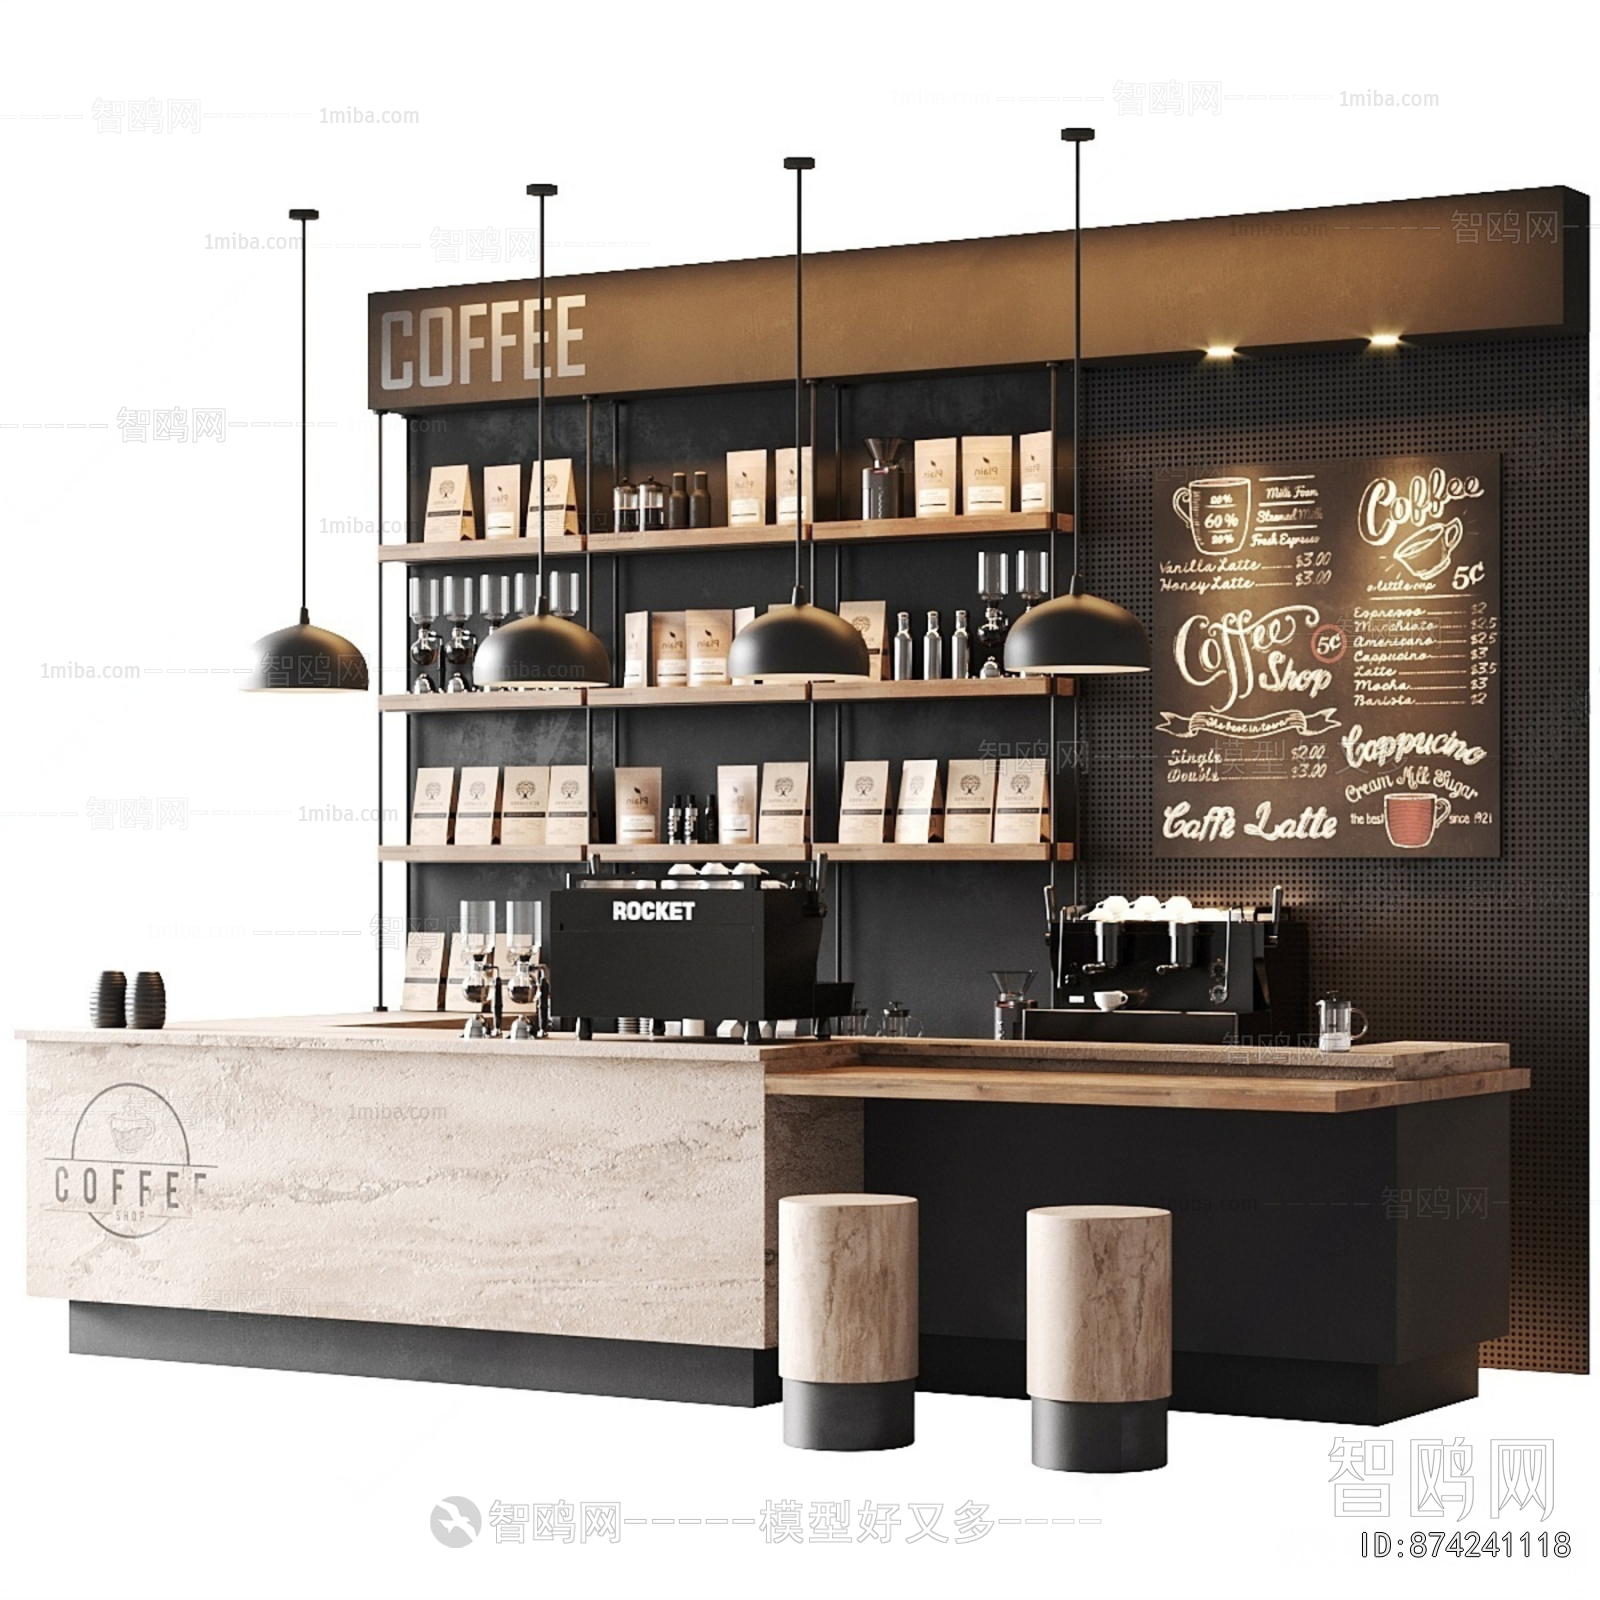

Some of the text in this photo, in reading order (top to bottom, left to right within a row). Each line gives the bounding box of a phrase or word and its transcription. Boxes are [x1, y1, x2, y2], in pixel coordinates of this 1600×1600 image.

[380, 294, 587, 391] COFFEE
[1358, 467, 1485, 546] Coffee
[1159, 551, 1332, 575] Vanilla Latte $3.00
[1159, 569, 1332, 595] Honey Latte $3.00
[1353, 606, 1426, 622] Espresso
[1353, 635, 1437, 648] Americano
[1173, 604, 1320, 713] Coffee
[1470, 646, 1489, 661] $3
[1258, 650, 1333, 699] Shop
[1353, 665, 1398, 678] Latte
[1353, 676, 1489, 692] Mocha $3
[1353, 693, 1416, 707] Barista
[1341, 723, 1488, 769] Cappucino
[1166, 748, 1223, 768] Single
[1166, 767, 1220, 783] Double
[1344, 774, 1395, 804] Cream
[1432, 768, 1479, 800] Sugar
[1243, 800, 1338, 842] Latte
[1349, 812, 1385, 825] the best
[612, 900, 696, 921] ROCKET
[115, 1210, 146, 1223] SHOP
